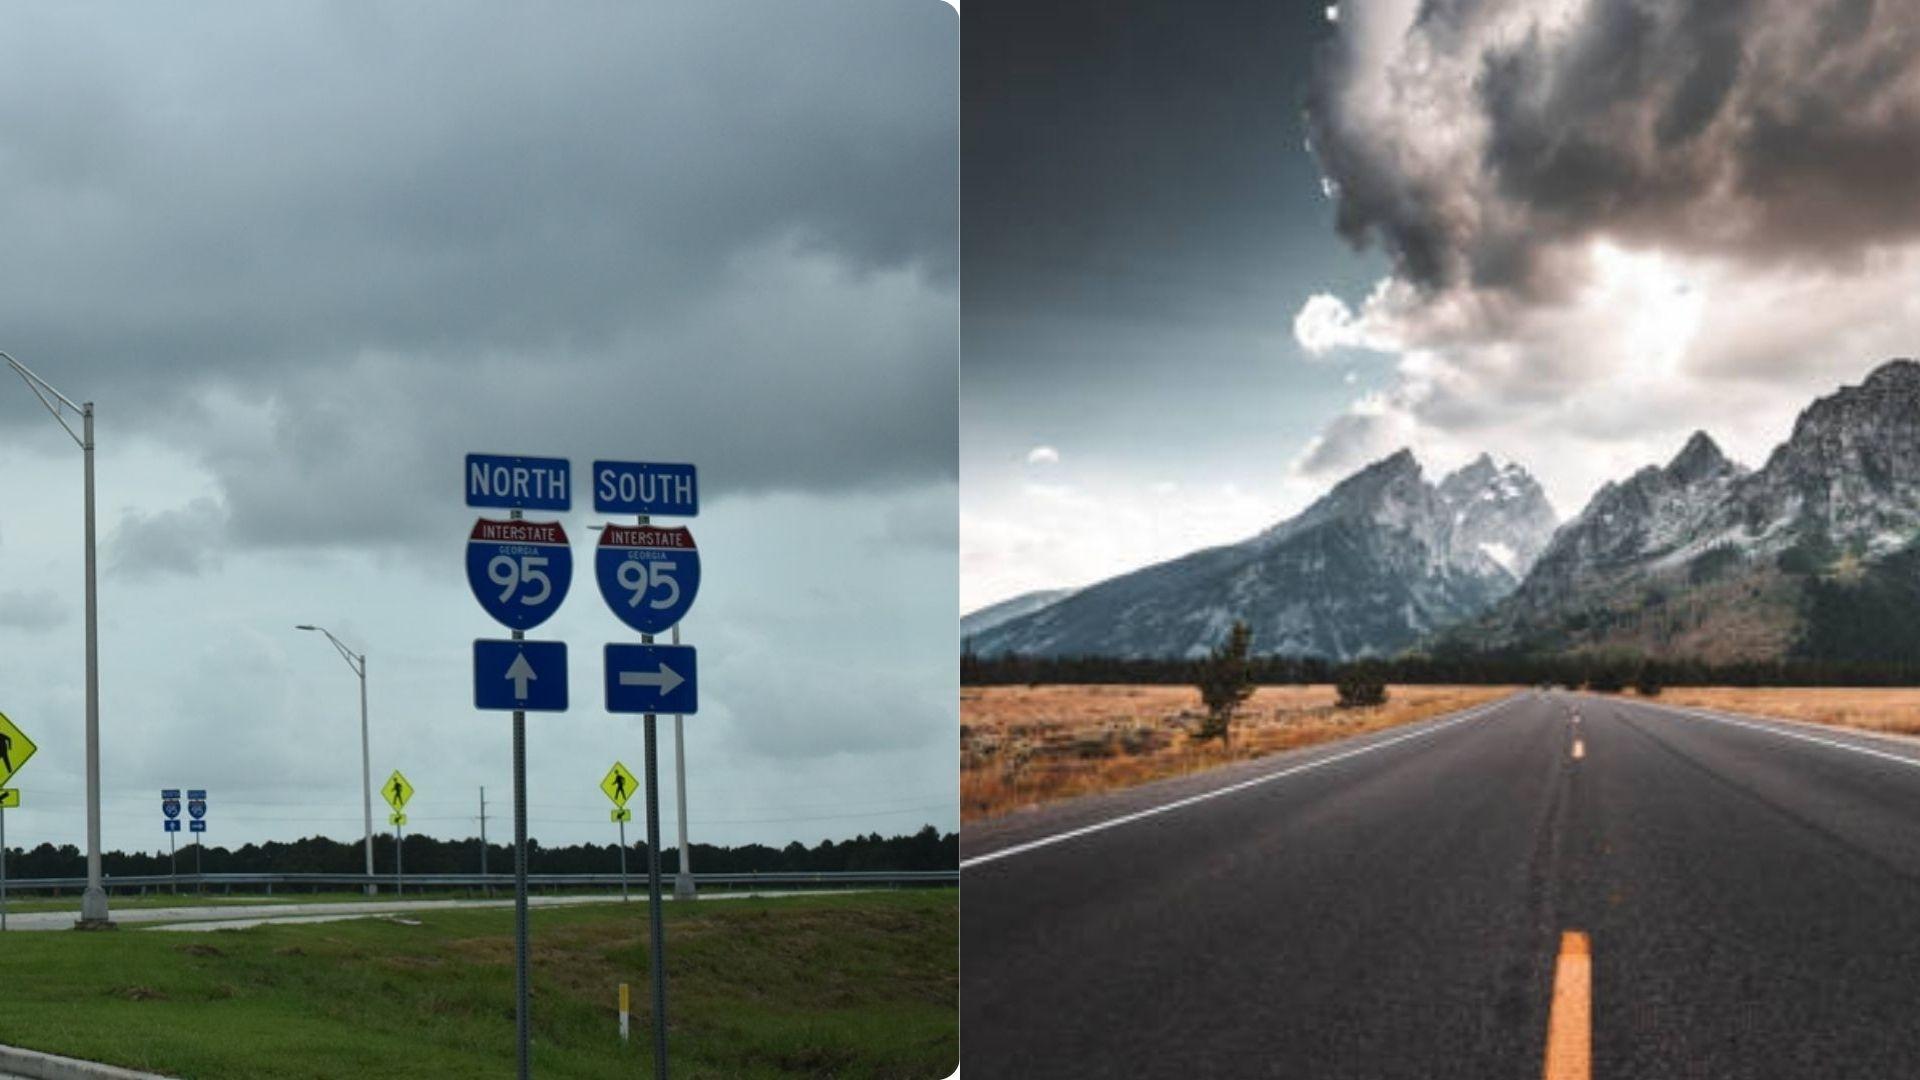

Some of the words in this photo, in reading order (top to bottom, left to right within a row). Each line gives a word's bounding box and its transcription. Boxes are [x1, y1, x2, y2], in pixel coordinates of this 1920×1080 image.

[471, 462, 565, 500] NORTH
[599, 469, 692, 504] SOUTH
[482, 525, 555, 541] INTERSTATE
[611, 531, 683, 547] INTERSTATE
[498, 545, 539, 555] GEORGIA
[627, 550, 667, 560] GEORGIA
[487, 555, 552, 606] 95
[616, 560, 680, 610] 95
